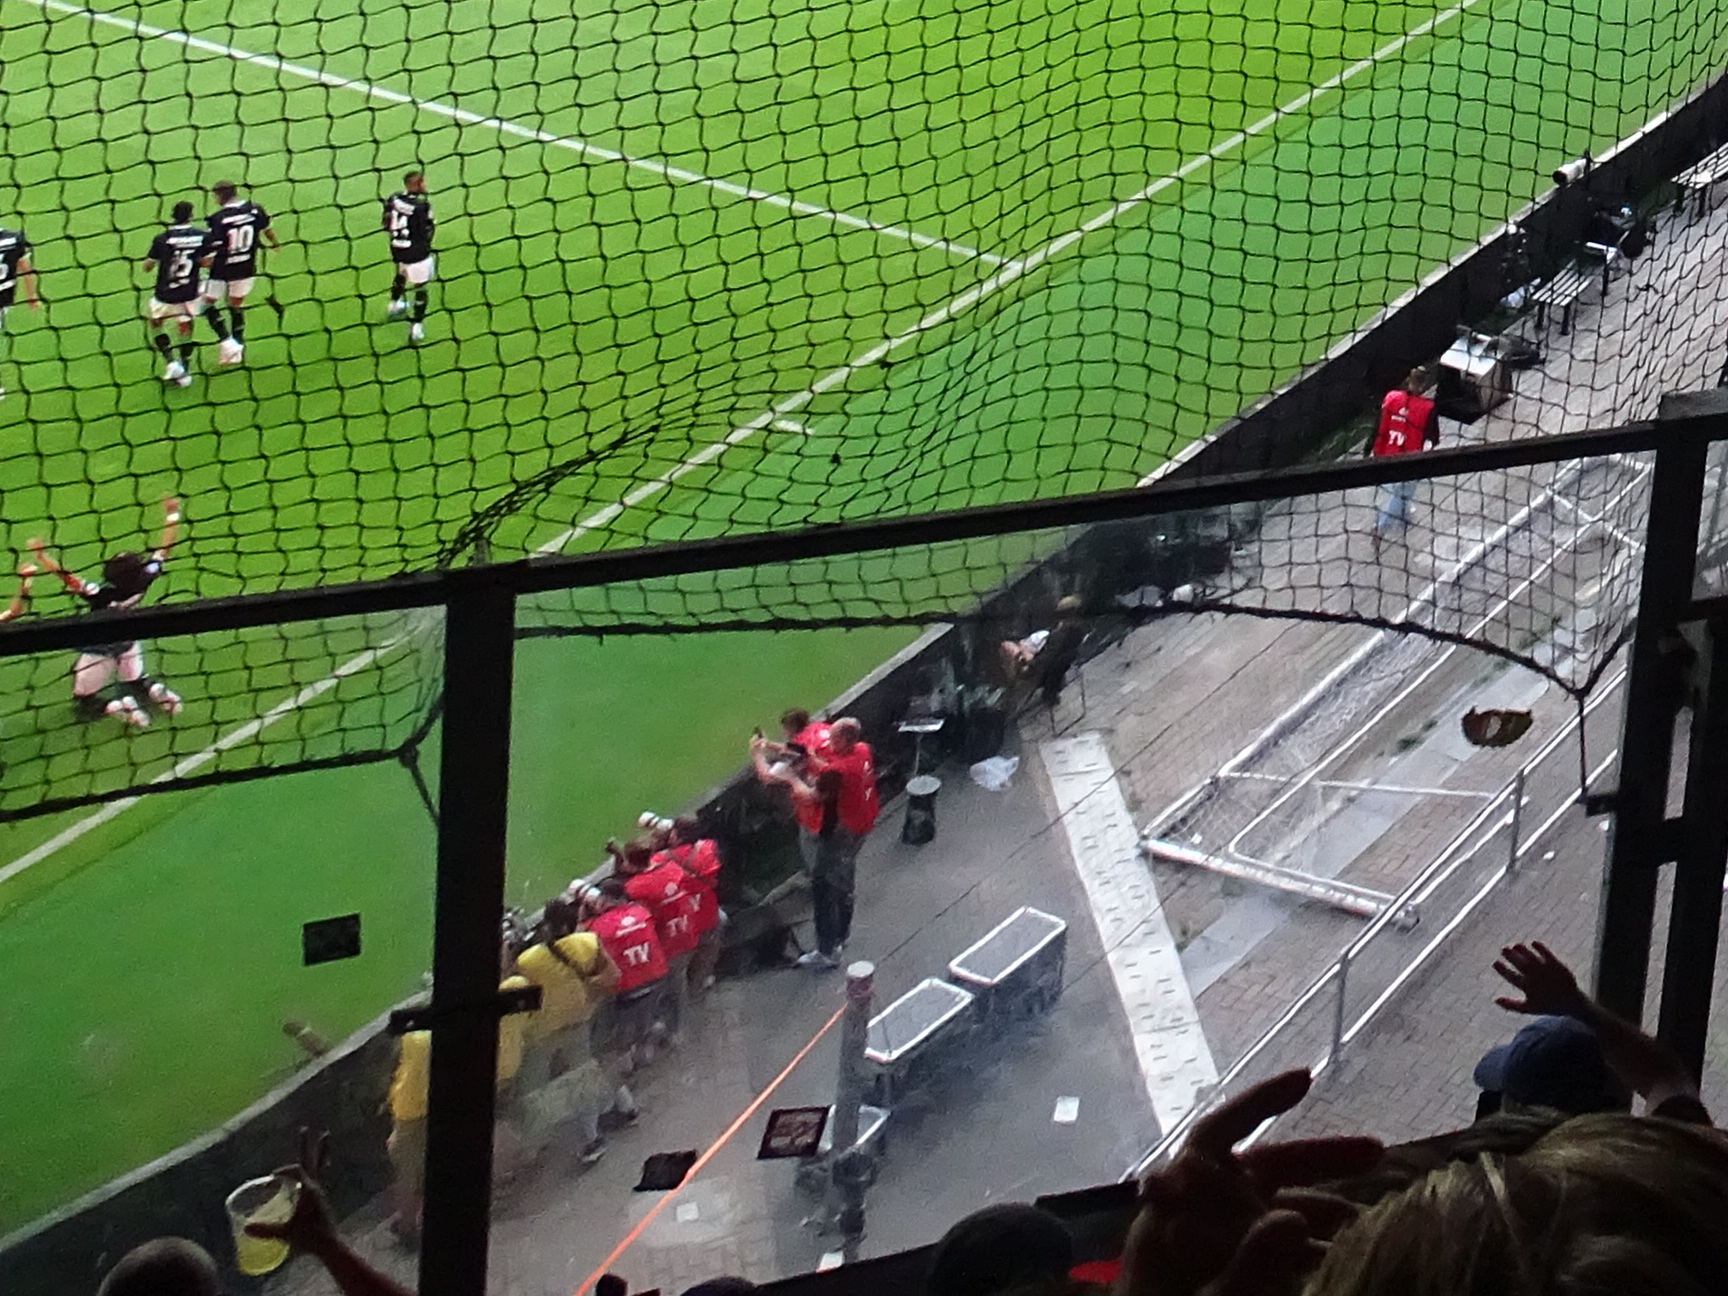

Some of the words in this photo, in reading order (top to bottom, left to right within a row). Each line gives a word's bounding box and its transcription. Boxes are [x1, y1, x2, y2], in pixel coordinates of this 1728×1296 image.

[227, 224, 254, 255] 10
[1388, 429, 1407, 447] TV
[666, 914, 689, 938] TV
[623, 942, 650, 967] TV
